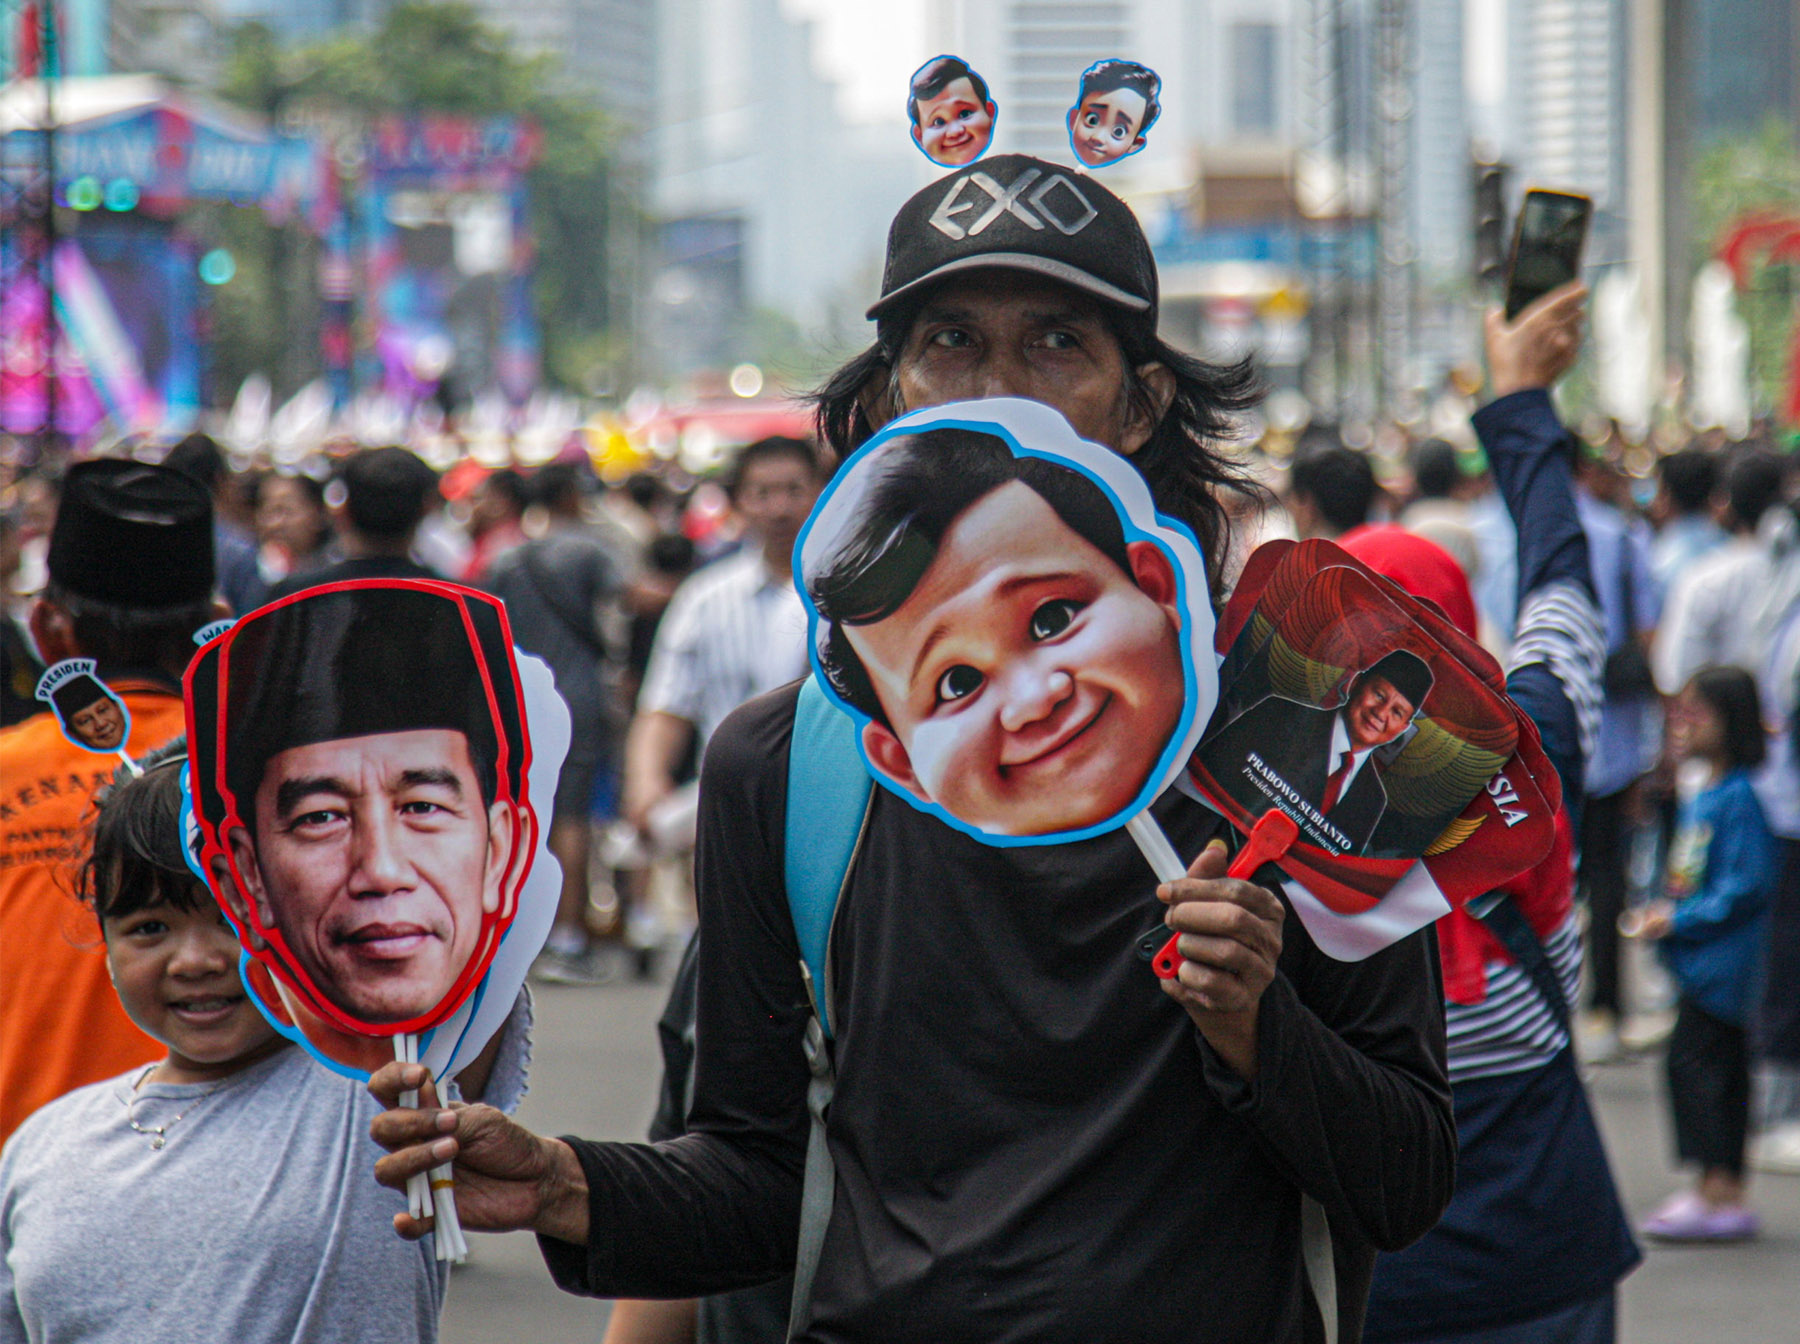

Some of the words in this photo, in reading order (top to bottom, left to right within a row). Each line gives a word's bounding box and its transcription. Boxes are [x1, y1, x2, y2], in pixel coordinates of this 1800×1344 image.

[928, 168, 1098, 241] EXO
[38, 661, 92, 698] PRESIDEN
[1242, 766, 1274, 798] Presiden
[1271, 795, 1306, 827] Republik
[1303, 823, 1340, 857] Indonesia
[1246, 752, 1300, 804] PRABOWO
[1297, 800, 1352, 850] SUBIANTO
[1486, 769, 1529, 828] SIA
